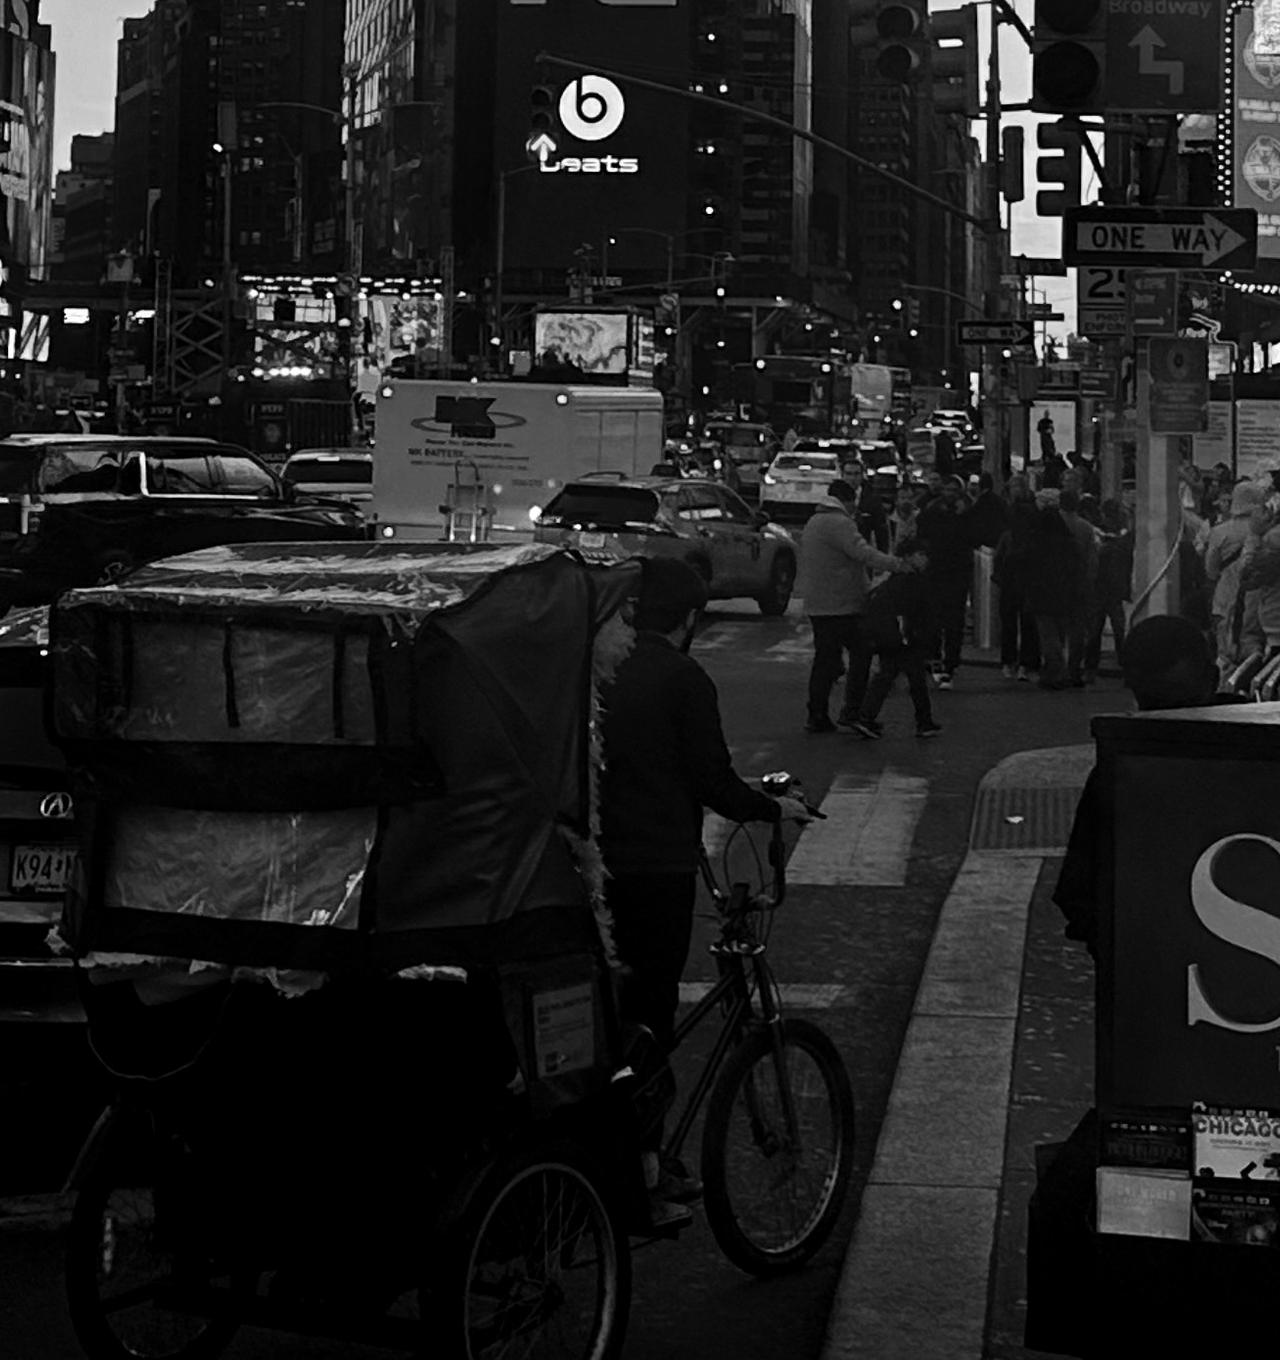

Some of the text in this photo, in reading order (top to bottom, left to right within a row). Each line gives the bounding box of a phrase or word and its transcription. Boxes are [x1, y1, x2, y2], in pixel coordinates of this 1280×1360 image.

[1091, 226, 1239, 251] ONE WAY
[1088, 269, 1125, 298] 2
